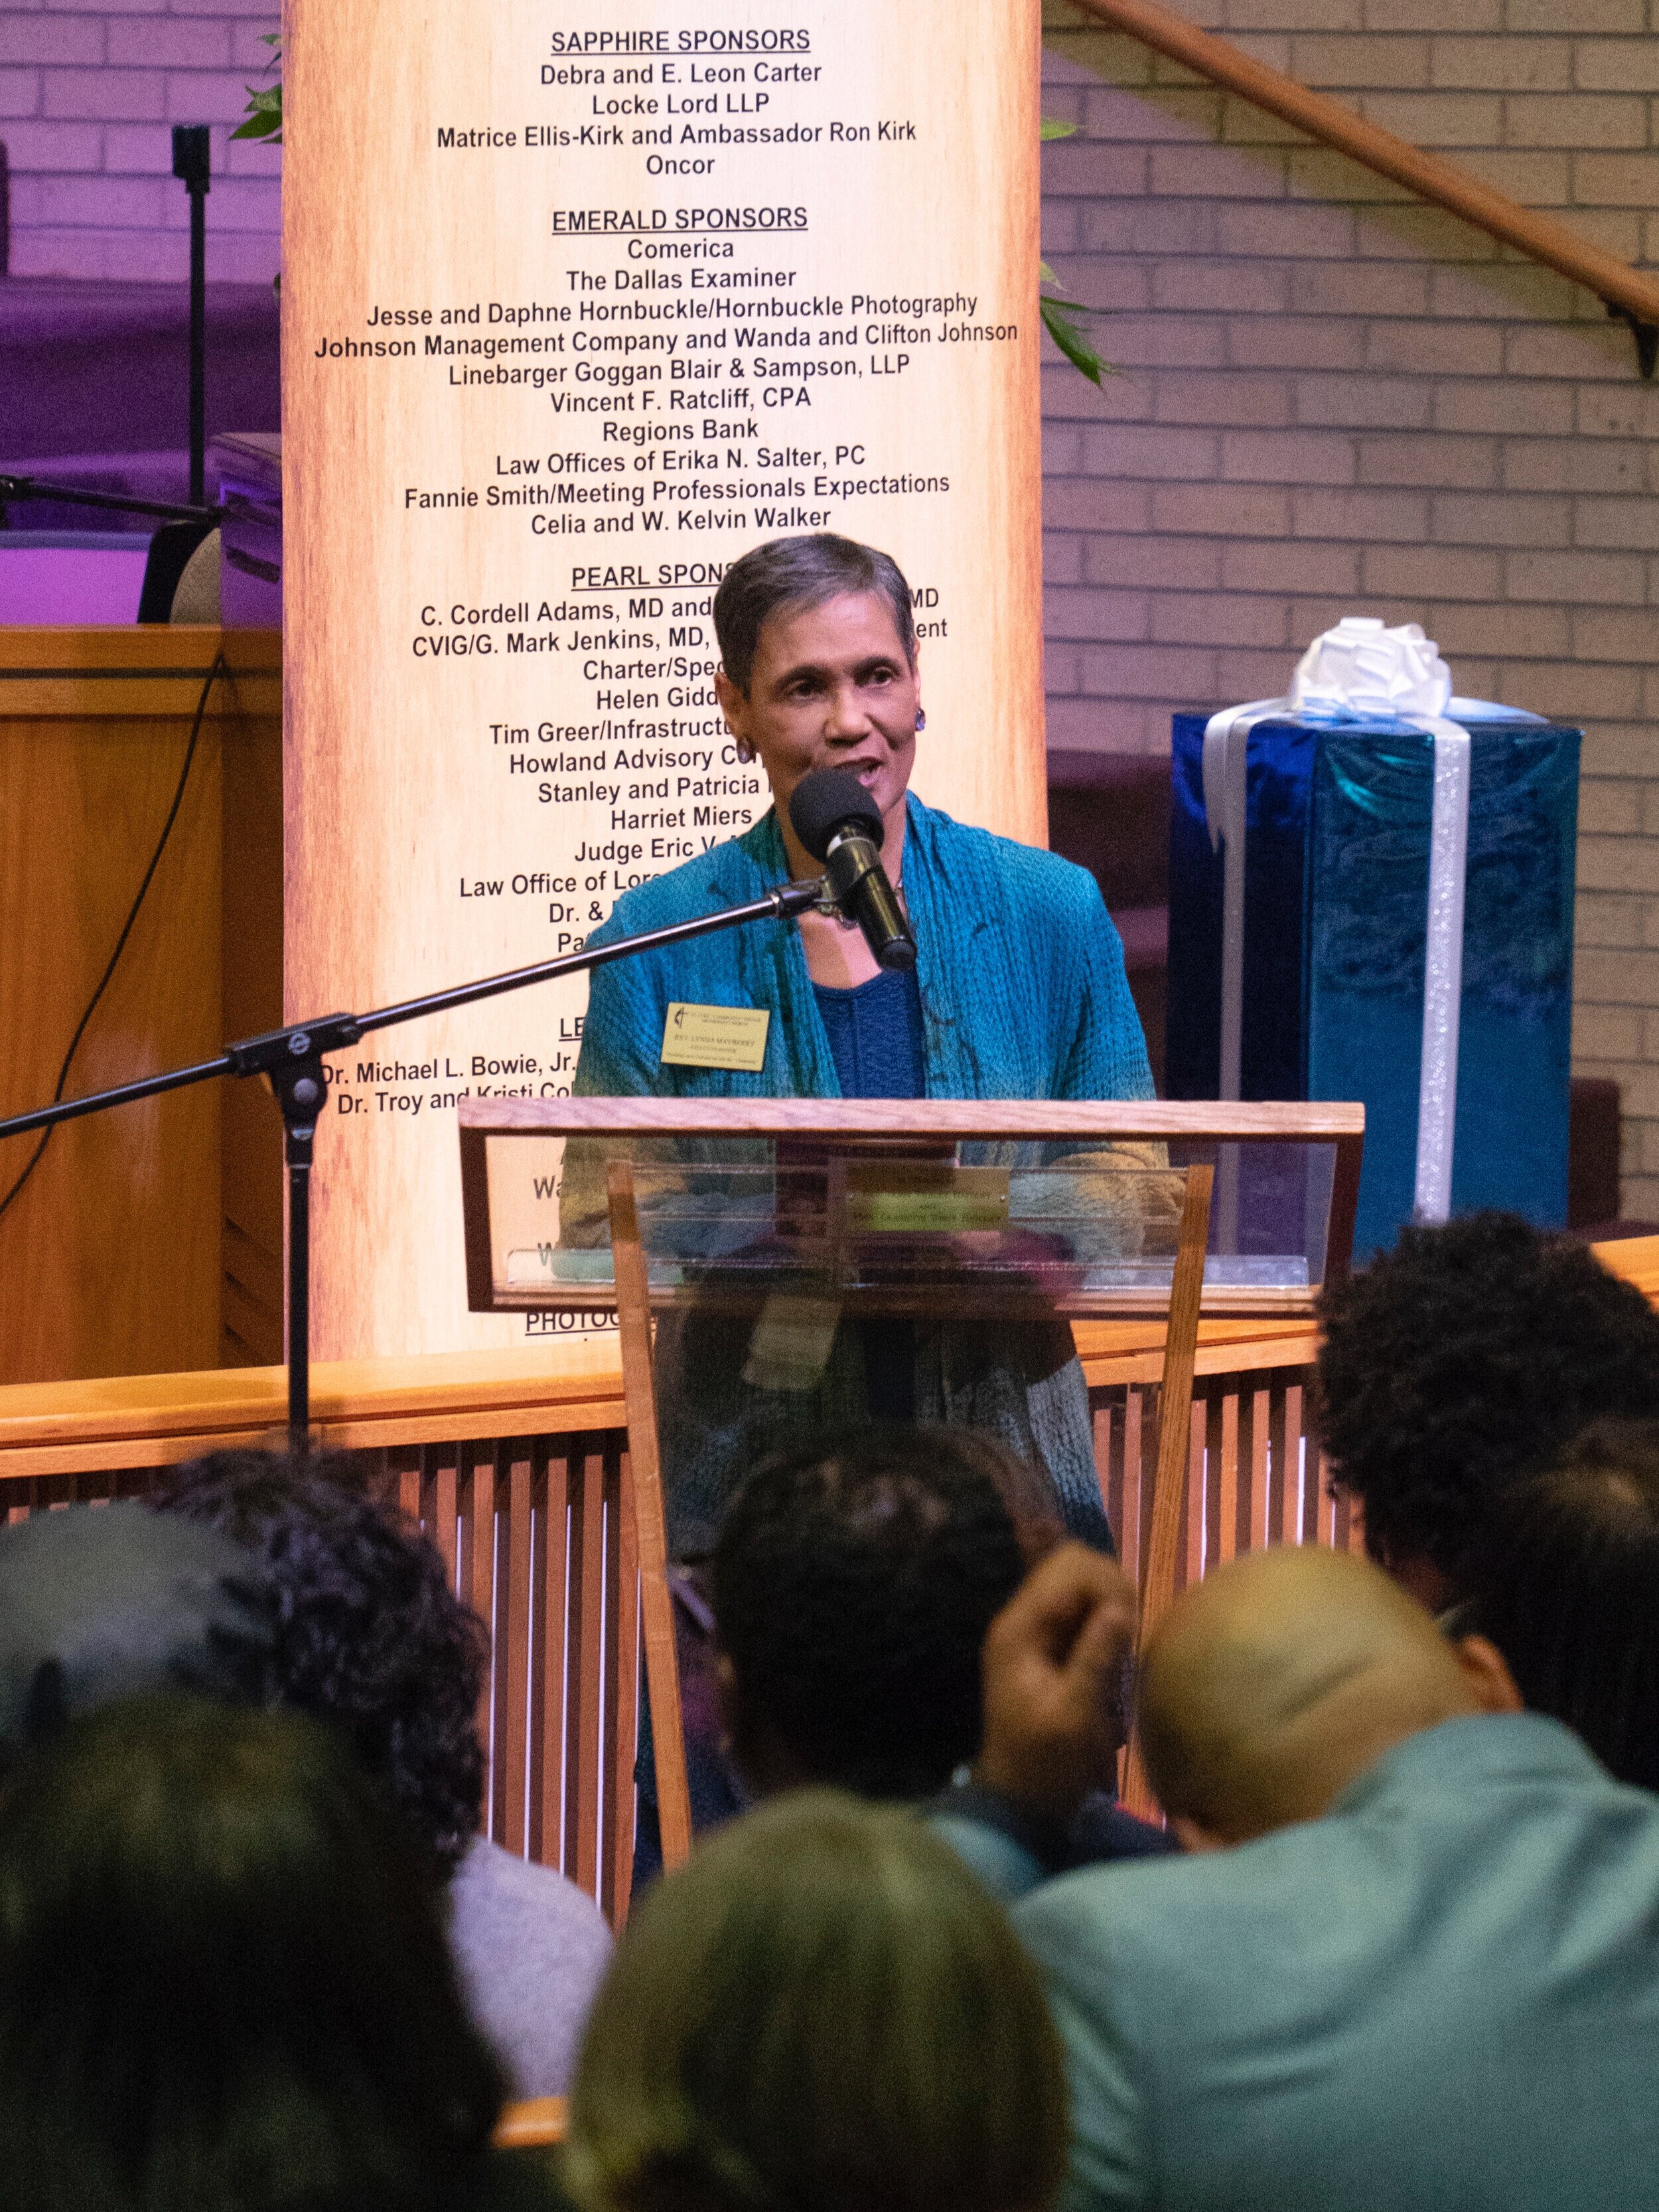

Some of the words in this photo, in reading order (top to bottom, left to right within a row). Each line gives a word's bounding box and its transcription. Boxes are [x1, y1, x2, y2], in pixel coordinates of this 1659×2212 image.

[551, 31, 670, 52] SAPPHIRE
[678, 30, 810, 50] SPONSORS
[541, 65, 605, 84] Debra
[613, 64, 652, 84] and
[662, 64, 681, 83] E.
[691, 64, 745, 82] Leon
[754, 62, 822, 82] Carter
[593, 95, 658, 114] Locke
[668, 94, 717, 113] Lord
[727, 93, 769, 113] LLP
[438, 127, 516, 147] Matrice
[526, 125, 623, 146] Ellis-Kirk
[632, 125, 672, 145] and
[680, 123, 822, 143] Ambassador
[830, 122, 870, 141] Ron
[879, 121, 916, 140] Kirk
[646, 155, 715, 175] Oncor
[553, 210, 666, 231] EMERALD
[676, 208, 808, 229] SPONSORS
[628, 238, 733, 259] Comerica
[567, 271, 606, 290] The
[615, 269, 682, 289] Dallas
[691, 267, 796, 288] Examiner
[367, 306, 432, 326] Jesse
[441, 304, 480, 325] and
[488, 303, 571, 327] Daphne
[581, 296, 843, 321] Hornbuckle/Hornbuckle
[852, 293, 977, 318] Photography
[315, 337, 415, 358] Johnson
[425, 333, 564, 359] Management
[573, 331, 678, 355] Company
[686, 329, 726, 348] and
[735, 327, 810, 347] Wanda
[819, 326, 857, 346] and
[866, 324, 930, 344] Clifton
[938, 323, 1017, 342] Johnson
[450, 364, 567, 388] Linebarger
[575, 362, 662, 386] Goggan
[671, 359, 722, 379] Blair
[730, 358, 745, 378] &
[754, 358, 862, 381] Sampson,
[871, 354, 909, 374] LLP
[551, 392, 634, 412] Vincent
[643, 390, 660, 410] F.
[670, 388, 754, 410] Ratcliff,
[763, 387, 811, 407] CPA
[604, 421, 693, 446] Regions
[703, 418, 758, 439] Bank
[497, 456, 540, 475] Law
[547, 453, 625, 473] Offices
[634, 451, 655, 471] of
[664, 450, 718, 470] Erika
[727, 449, 747, 468] N.
[757, 447, 826, 468] Salter,
[836, 445, 865, 465] PC
[405, 487, 478, 508] Fannie
[486, 482, 644, 506] Smith/Meeting
[654, 477, 805, 500] Professionals
[814, 474, 949, 500] Expectations
[532, 514, 585, 534] Celia
[594, 512, 634, 532] and
[642, 511, 668, 531] W.
[678, 509, 746, 530] Kelvin
[755, 507, 831, 527] Walker
[573, 566, 650, 587] PEARL
[421, 606, 442, 626] C.
[451, 603, 528, 625] Cordell
[537, 601, 619, 621] Adams,
[629, 598, 663, 618] MD
[672, 597, 711, 617] and
[413, 634, 498, 657] CVIG/G.
[508, 632, 559, 652] Mark
[567, 629, 660, 650] Jenkins,
[670, 627, 709, 648] MD,
[597, 690, 658, 709] Helen
[490, 725, 529, 744] Tim
[510, 751, 605, 774] Howland
[614, 748, 713, 771] Advisory
[539, 781, 620, 805] Stanley
[628, 778, 668, 799] and
[678, 775, 758, 796] Patricia
[612, 808, 685, 830] Harriet
[694, 806, 752, 826] Miers
[575, 841, 642, 865] Judge
[652, 838, 693, 857] Eric
[461, 878, 504, 897] Law
[512, 873, 577, 895] Office
[585, 871, 607, 891] of
[550, 903, 579, 922] Dr.
[589, 901, 603, 921] &
[357, 1059, 437, 1082] Michael
[446, 1059, 463, 1077] L.
[472, 1054, 542, 1076] Bowie,
[550, 1052, 575, 1072] Jr.
[338, 1094, 368, 1114] Dr.
[375, 1092, 423, 1115] Troy
